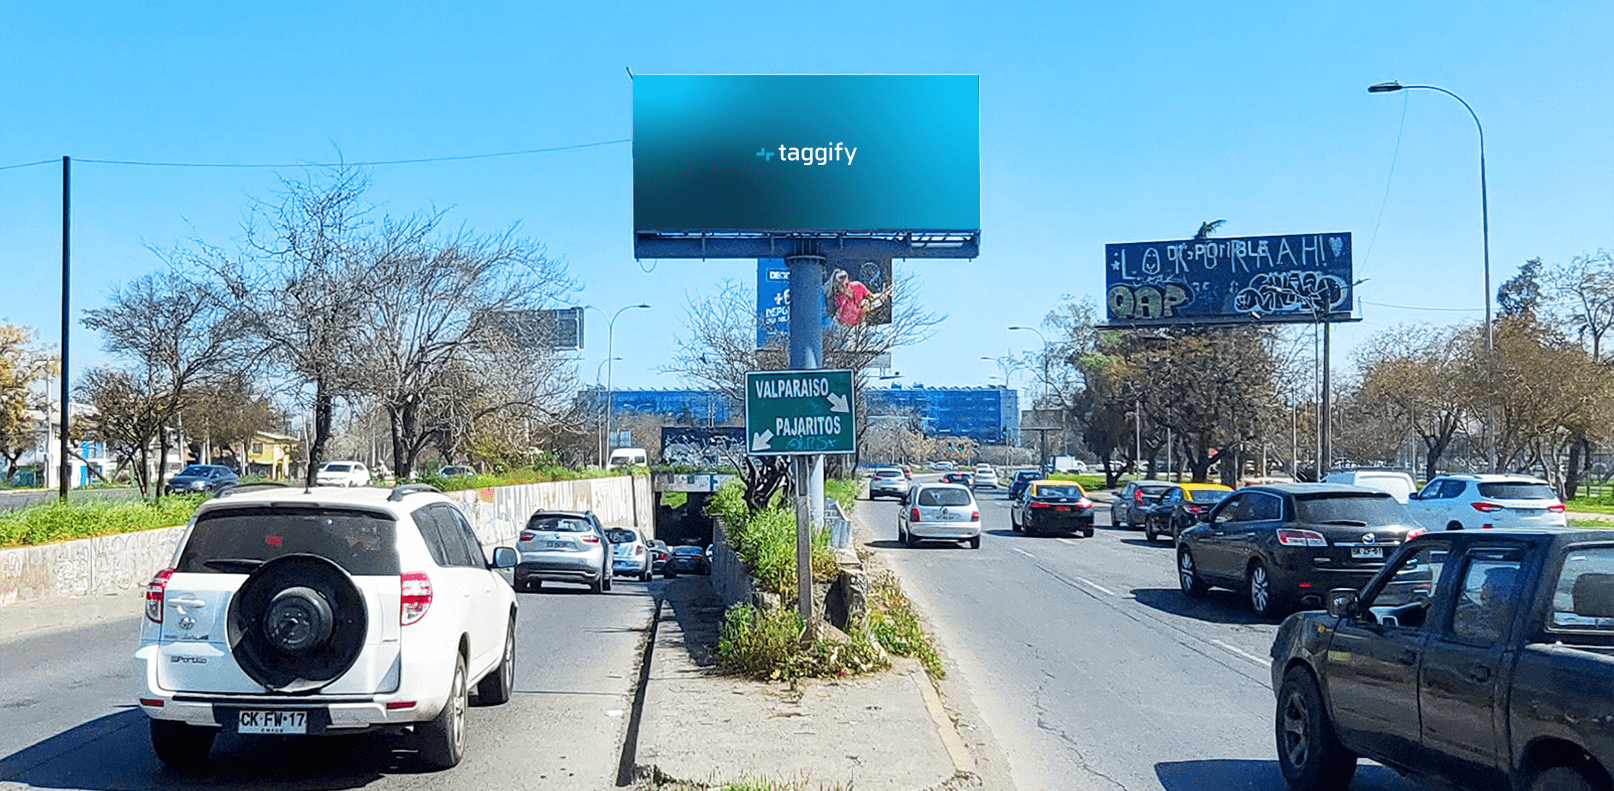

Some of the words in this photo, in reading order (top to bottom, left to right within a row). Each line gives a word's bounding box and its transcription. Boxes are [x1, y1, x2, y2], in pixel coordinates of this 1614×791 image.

[778, 141, 858, 166] taggify
[755, 377, 829, 399] VALPARAISO
[775, 415, 842, 437] PAJARITOS
